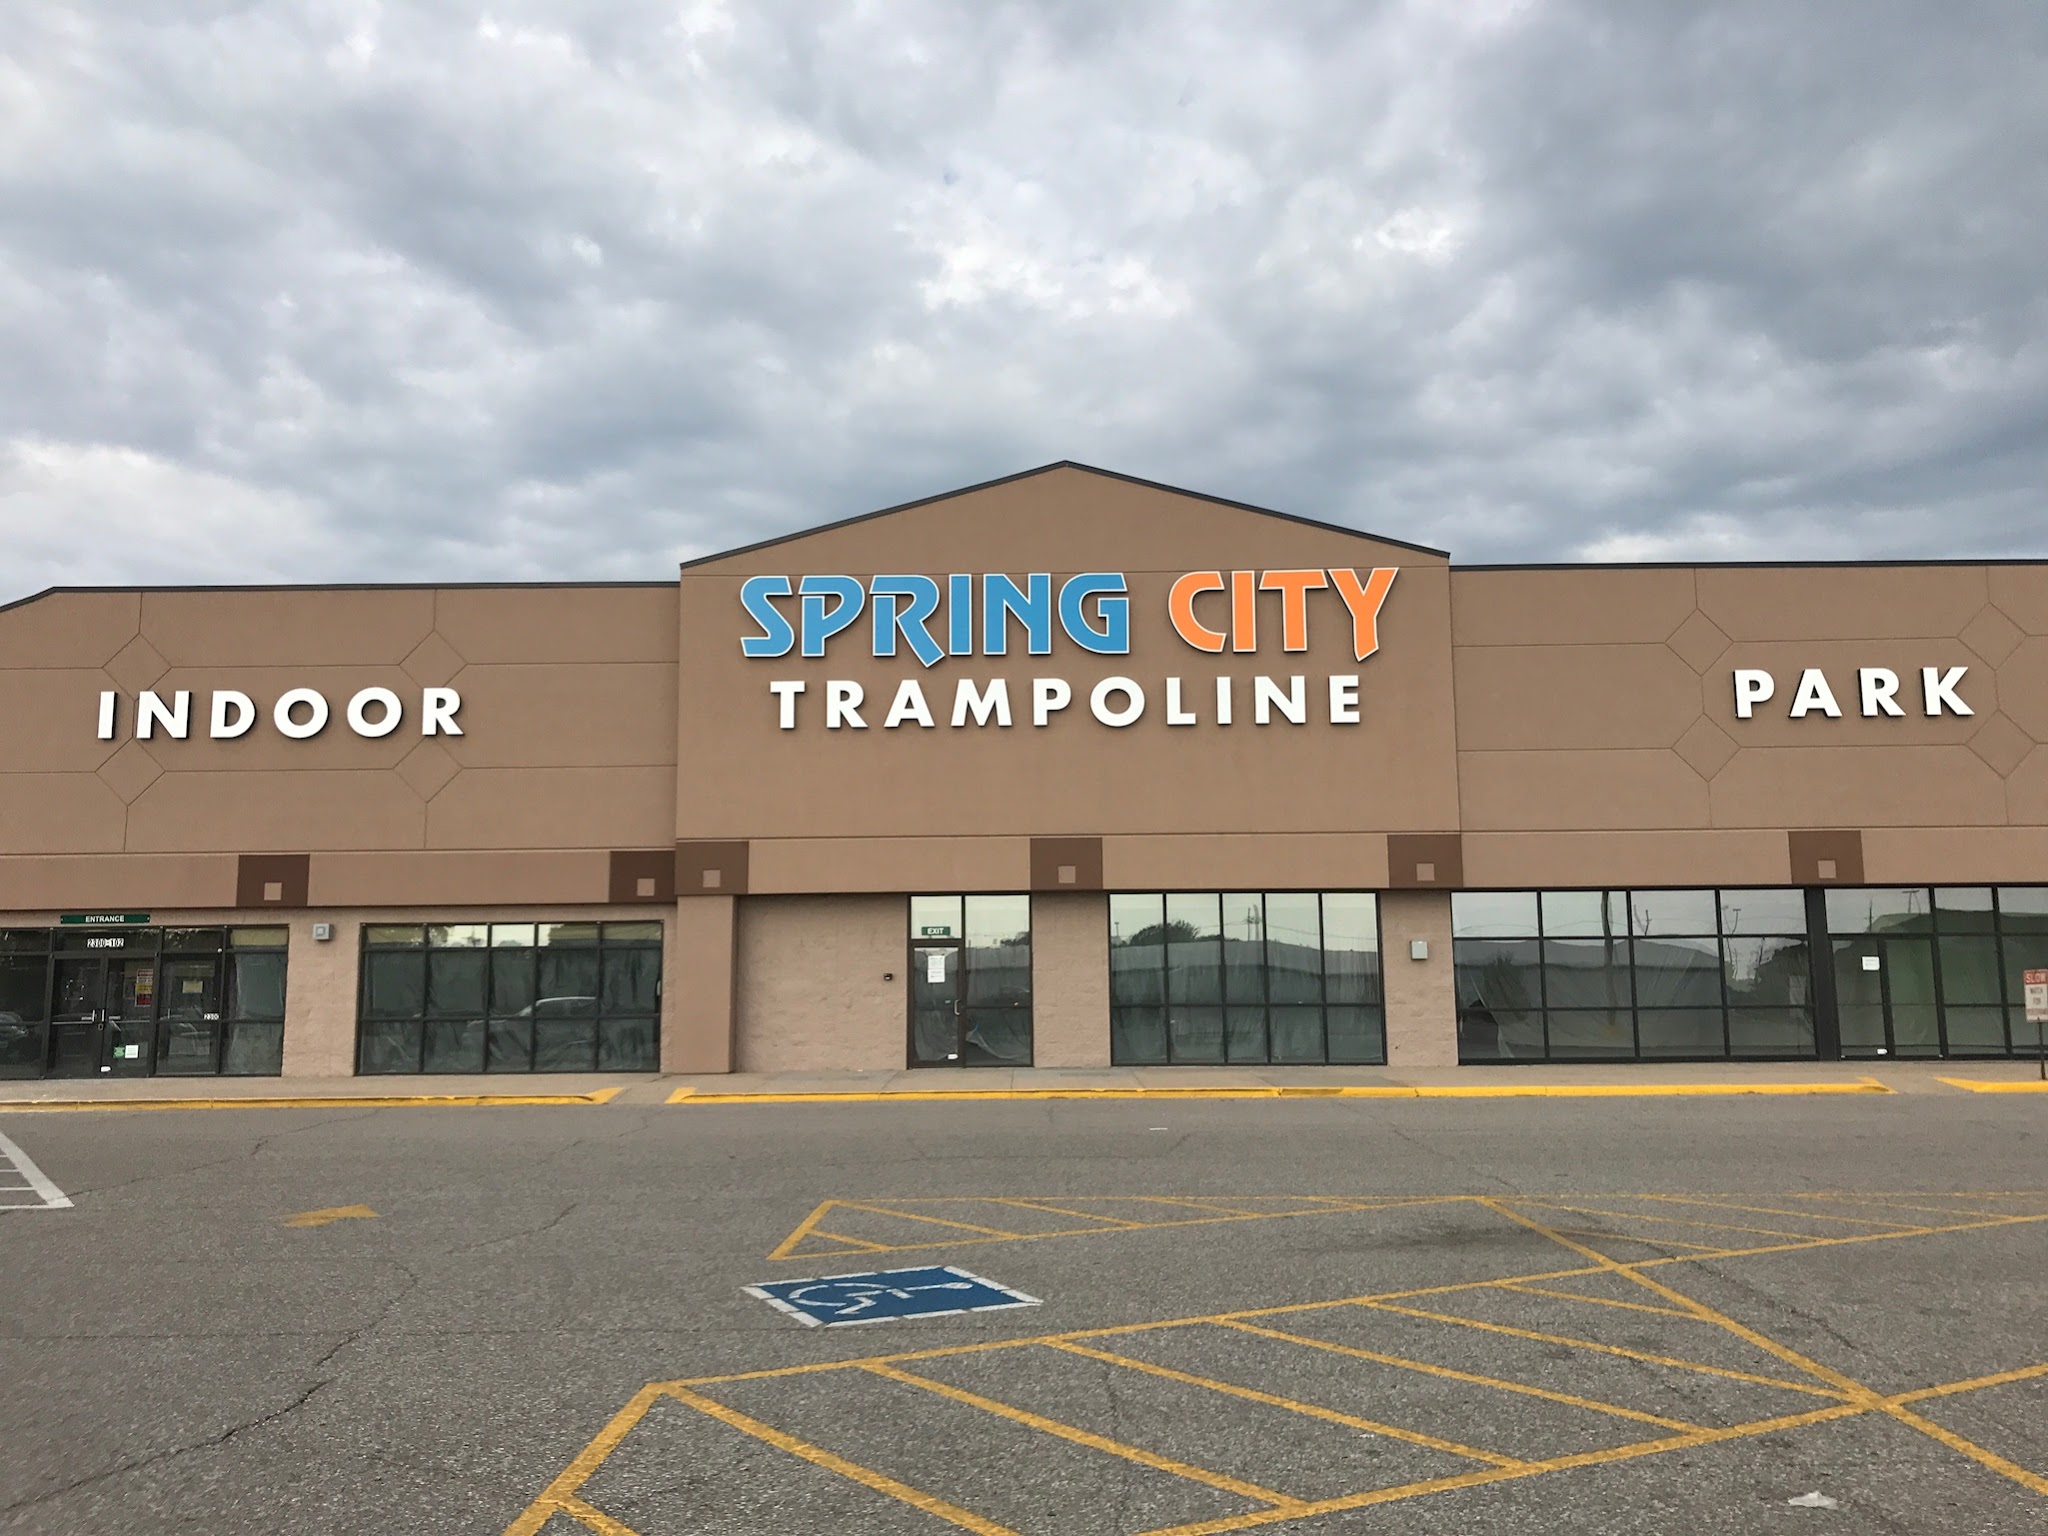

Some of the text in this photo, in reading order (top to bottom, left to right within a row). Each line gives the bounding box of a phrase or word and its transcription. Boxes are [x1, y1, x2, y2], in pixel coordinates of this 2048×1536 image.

[740, 567, 1399, 668] SPRING CITY
[97, 686, 464, 739] INDOOR
[770, 674, 1361, 729] TRAMPOLINE
[1733, 666, 1976, 718] PARK
[85, 914, 125, 923] ENTRANCE
[927, 927, 945, 935] EXIT
[2025, 972, 2047, 984] SLOW
